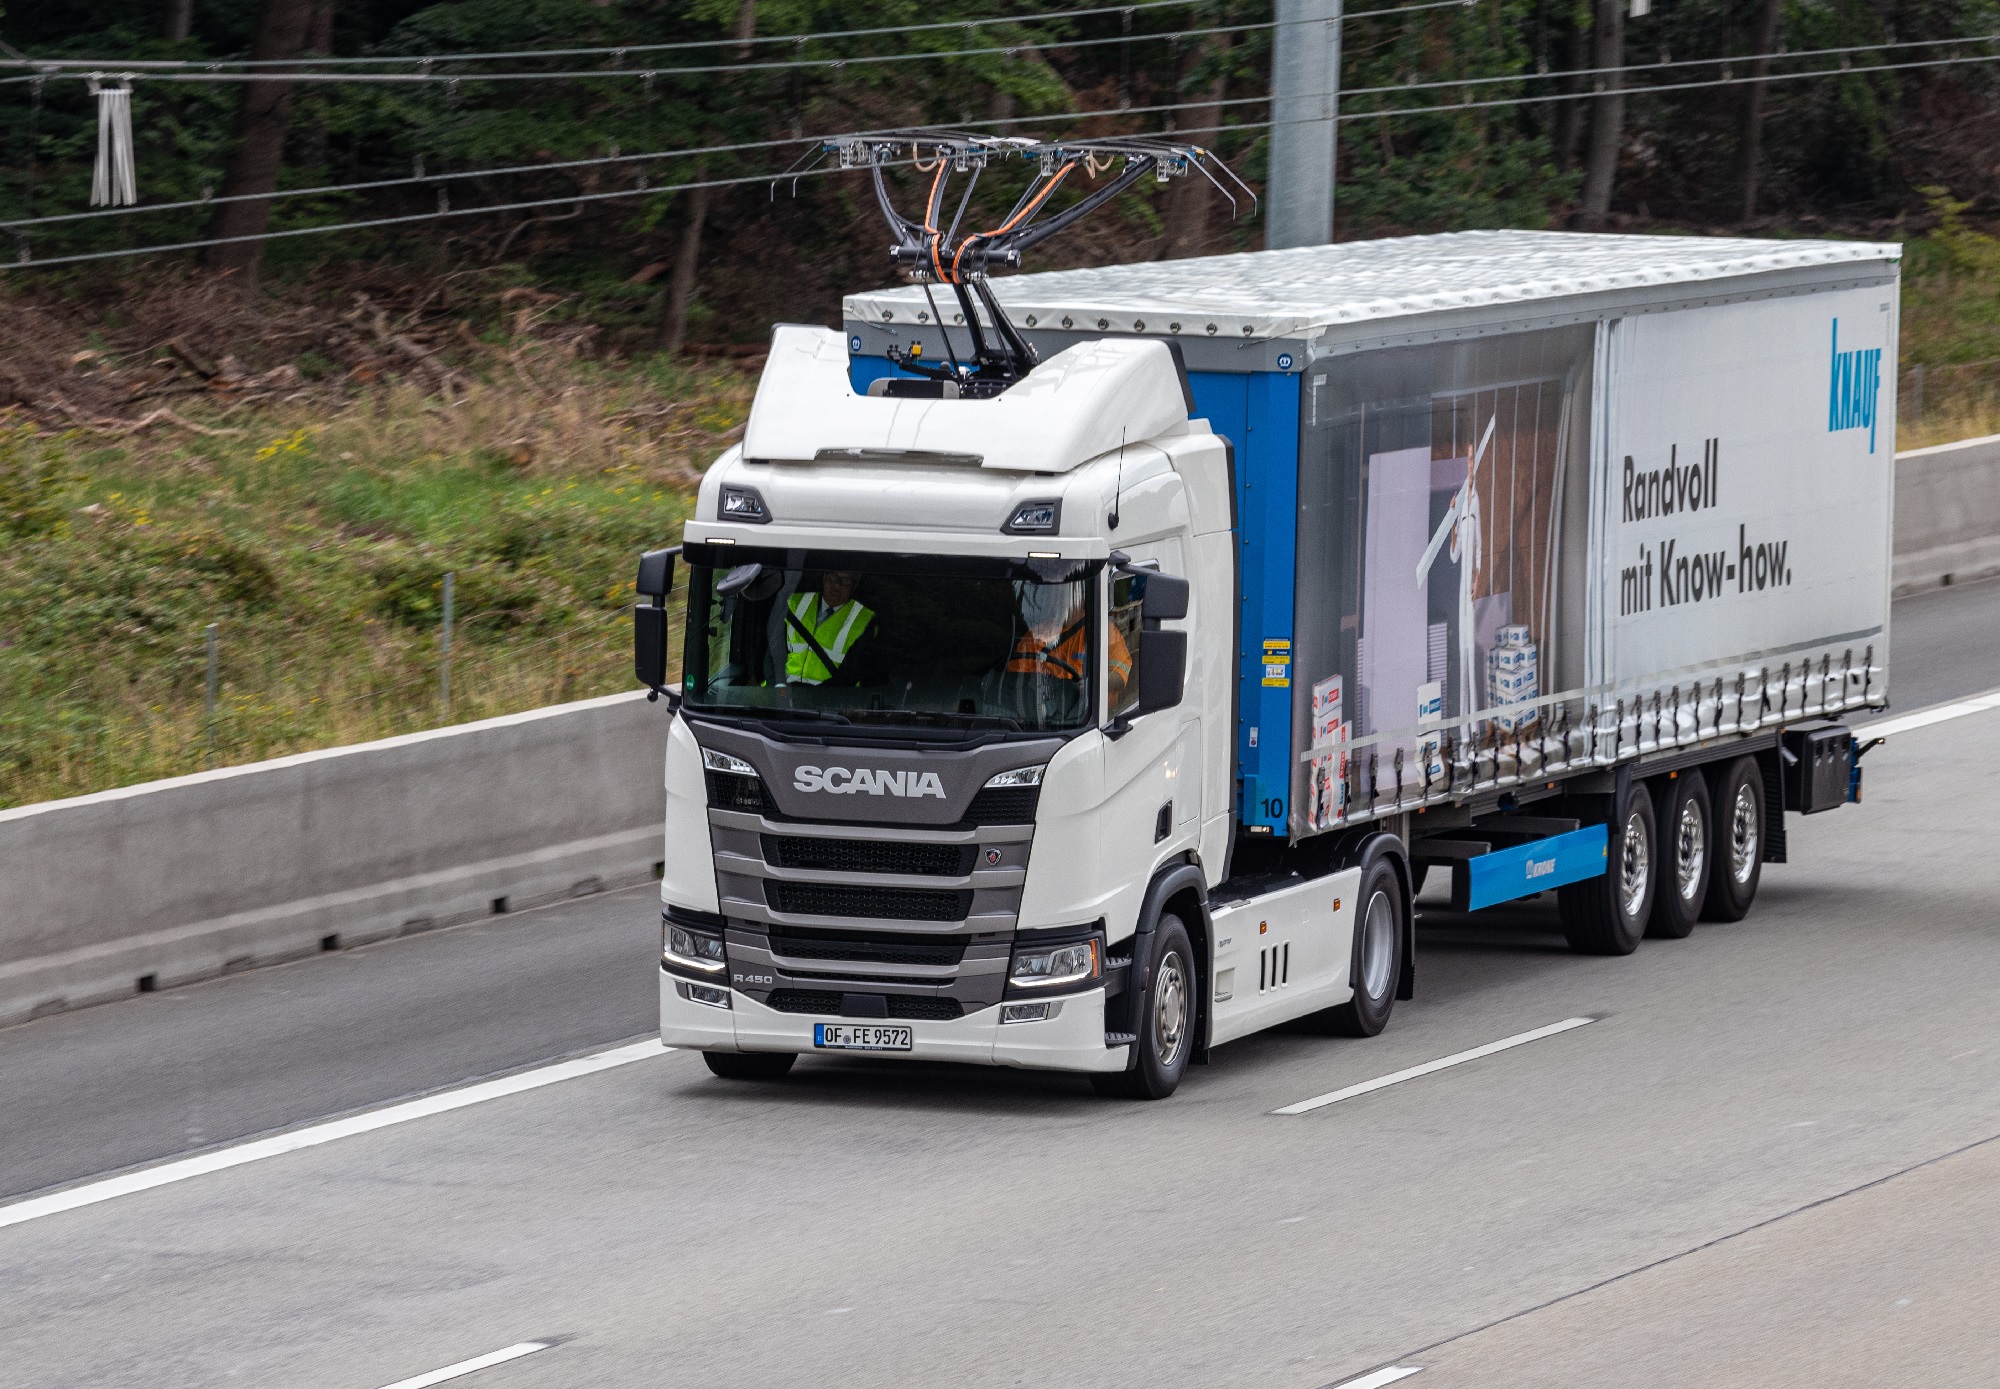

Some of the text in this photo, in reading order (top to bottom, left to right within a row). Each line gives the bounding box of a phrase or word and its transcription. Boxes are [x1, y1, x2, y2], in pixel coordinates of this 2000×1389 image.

[1828, 317, 1882, 454] KNAUF
[1622, 437, 1719, 524] Randvoll
[1620, 523, 1792, 617] mit Know-how.
[793, 765, 947, 799] SCANIA
[1260, 797, 1284, 819] 10
[733, 974, 773, 984] R 450
[825, 1027, 843, 1043] OF
[853, 1028, 871, 1044] FE
[874, 1028, 909, 1046] 9572
